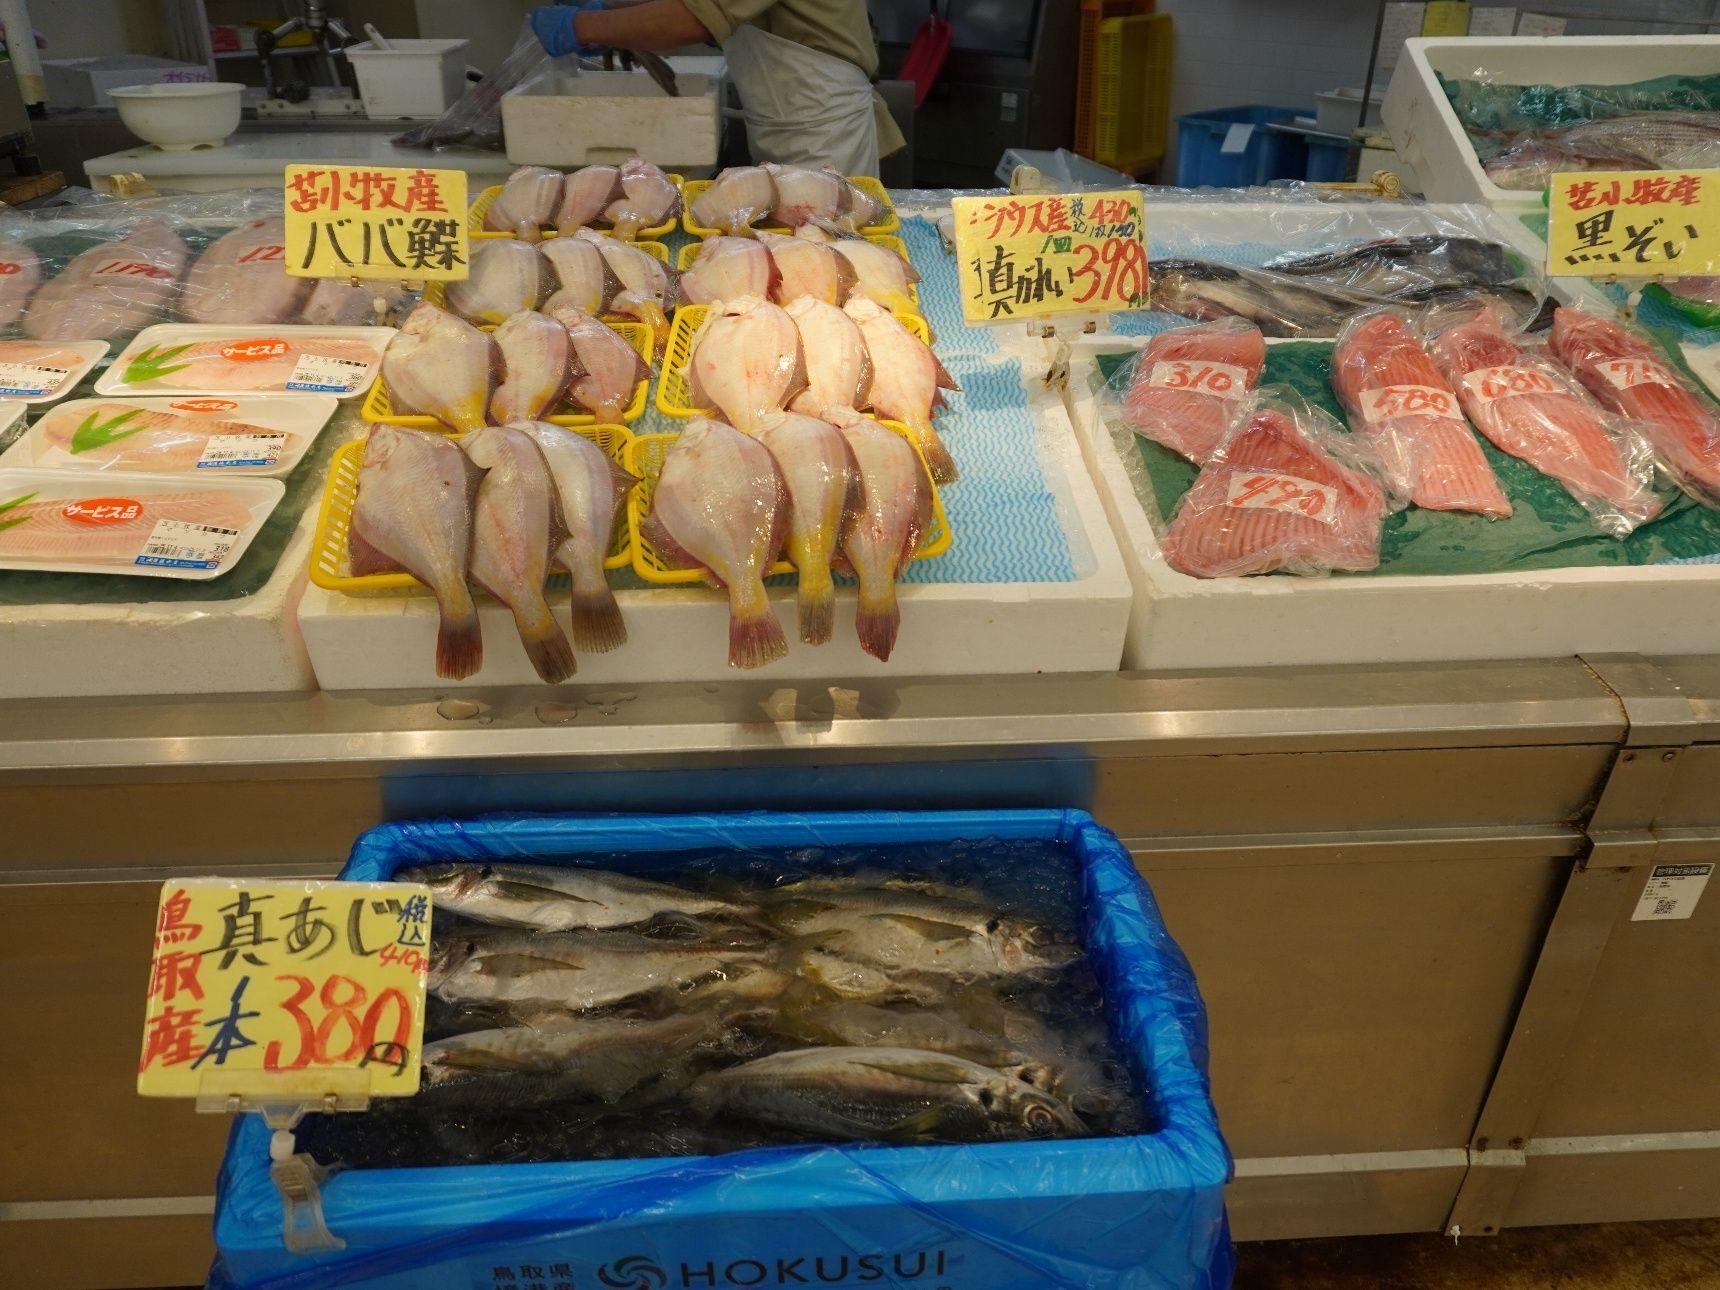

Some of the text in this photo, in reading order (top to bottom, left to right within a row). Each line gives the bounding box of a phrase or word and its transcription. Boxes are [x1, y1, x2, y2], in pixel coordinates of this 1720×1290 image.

[287, 169, 449, 213] 苫小牧産
[1564, 209, 1699, 266] 黒ぞい
[222, 343, 286, 357] サービス品
[1165, 362, 1233, 393] 310
[66, 503, 139, 520] サービス品
[1231, 474, 1328, 517] 490
[201, 891, 402, 970] 真あじ
[138, 889, 206, 1073] 鳥取産
[263, 973, 412, 1077] 380円
[680, 1249, 946, 1288] HOKUSUI
